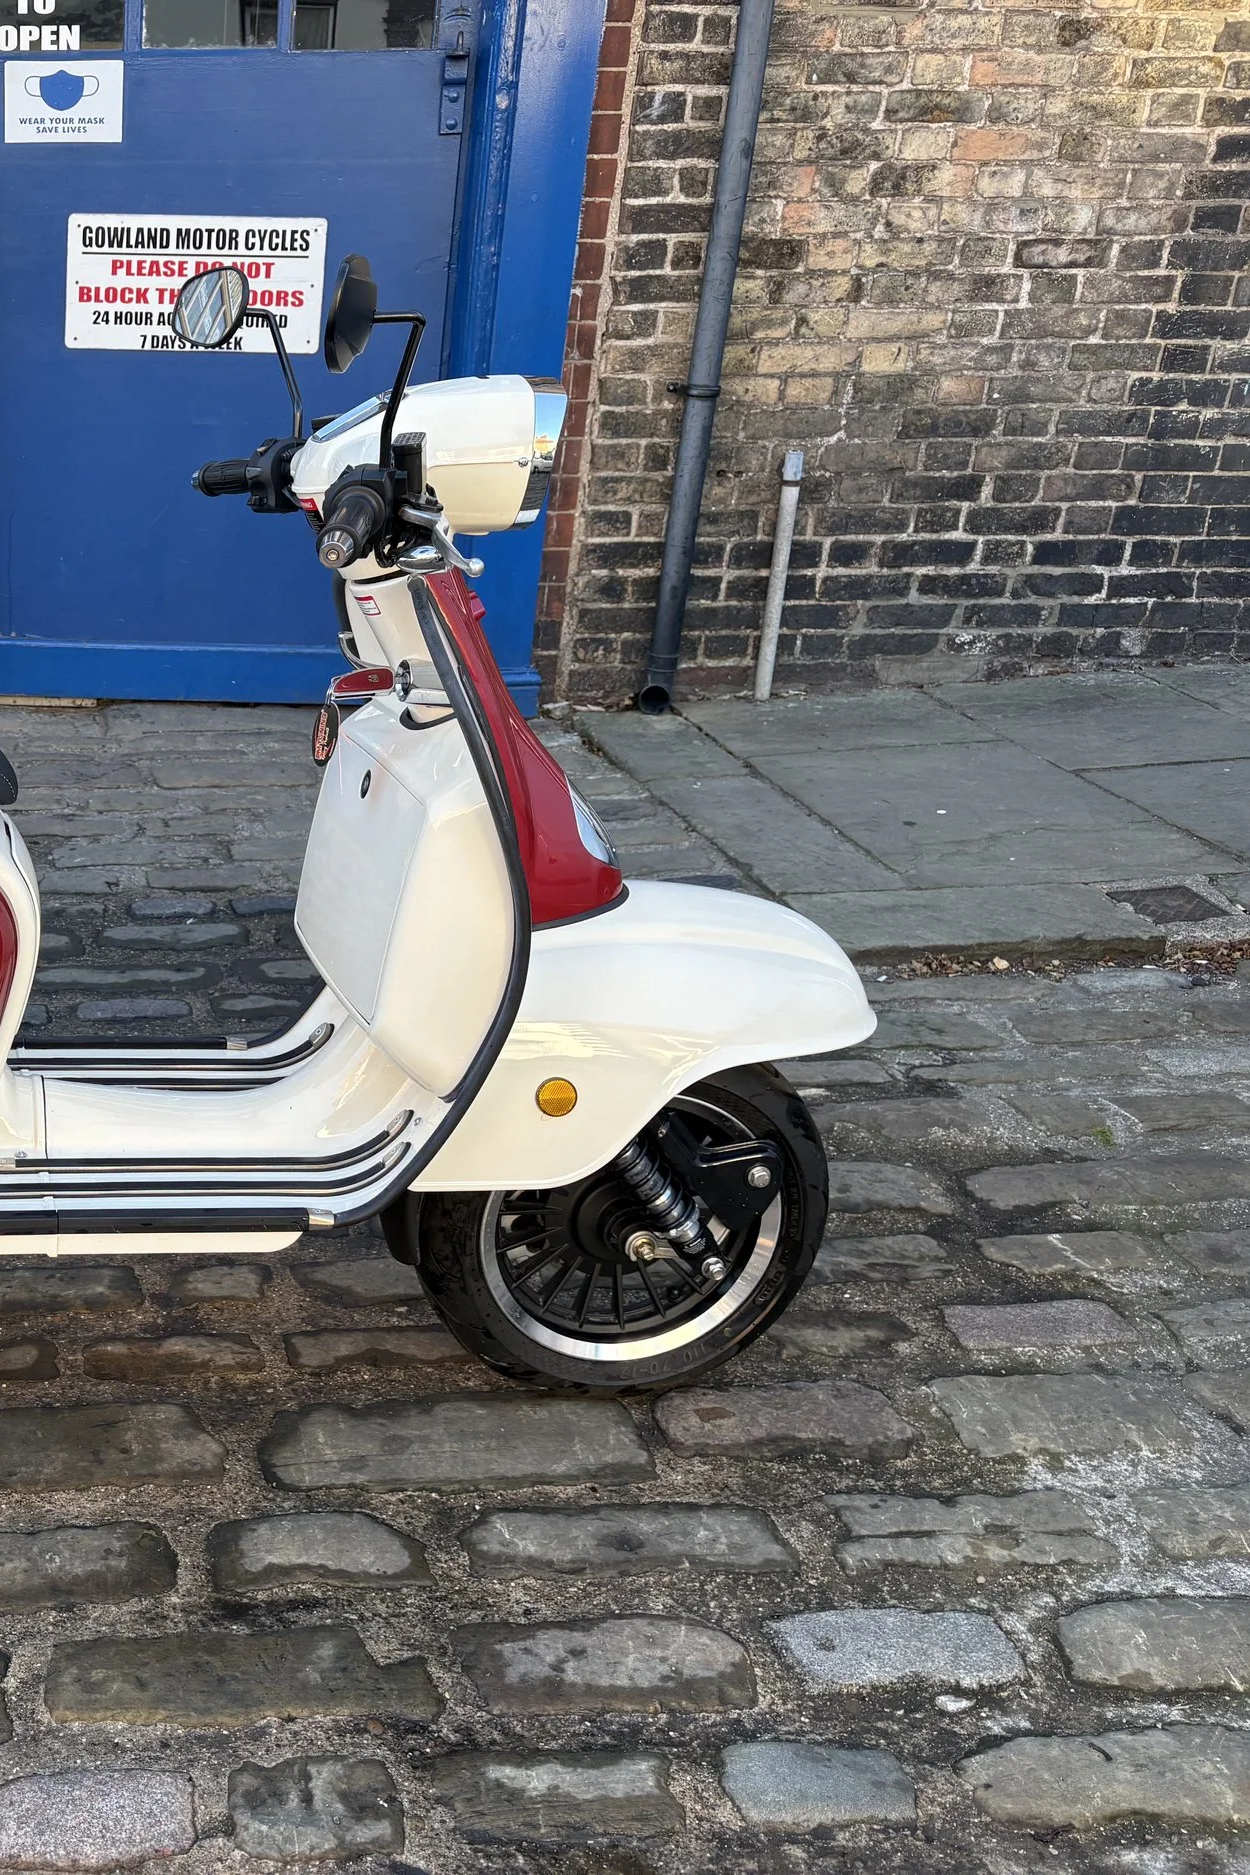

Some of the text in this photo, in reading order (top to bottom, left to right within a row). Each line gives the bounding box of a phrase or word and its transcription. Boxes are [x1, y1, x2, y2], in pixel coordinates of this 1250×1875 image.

[19, 117, 105, 125] WEAR YOUR MASK
[82, 225, 311, 252] GOWLAND MOTOR CYCLES
[111, 259, 188, 278] PLEASE
[78, 286, 149, 304] BLOCK
[92, 310, 110, 325] 24
[114, 311, 153, 326] HOUR
[140, 334, 148, 349] 7
[151, 335, 187, 350] DAYS
